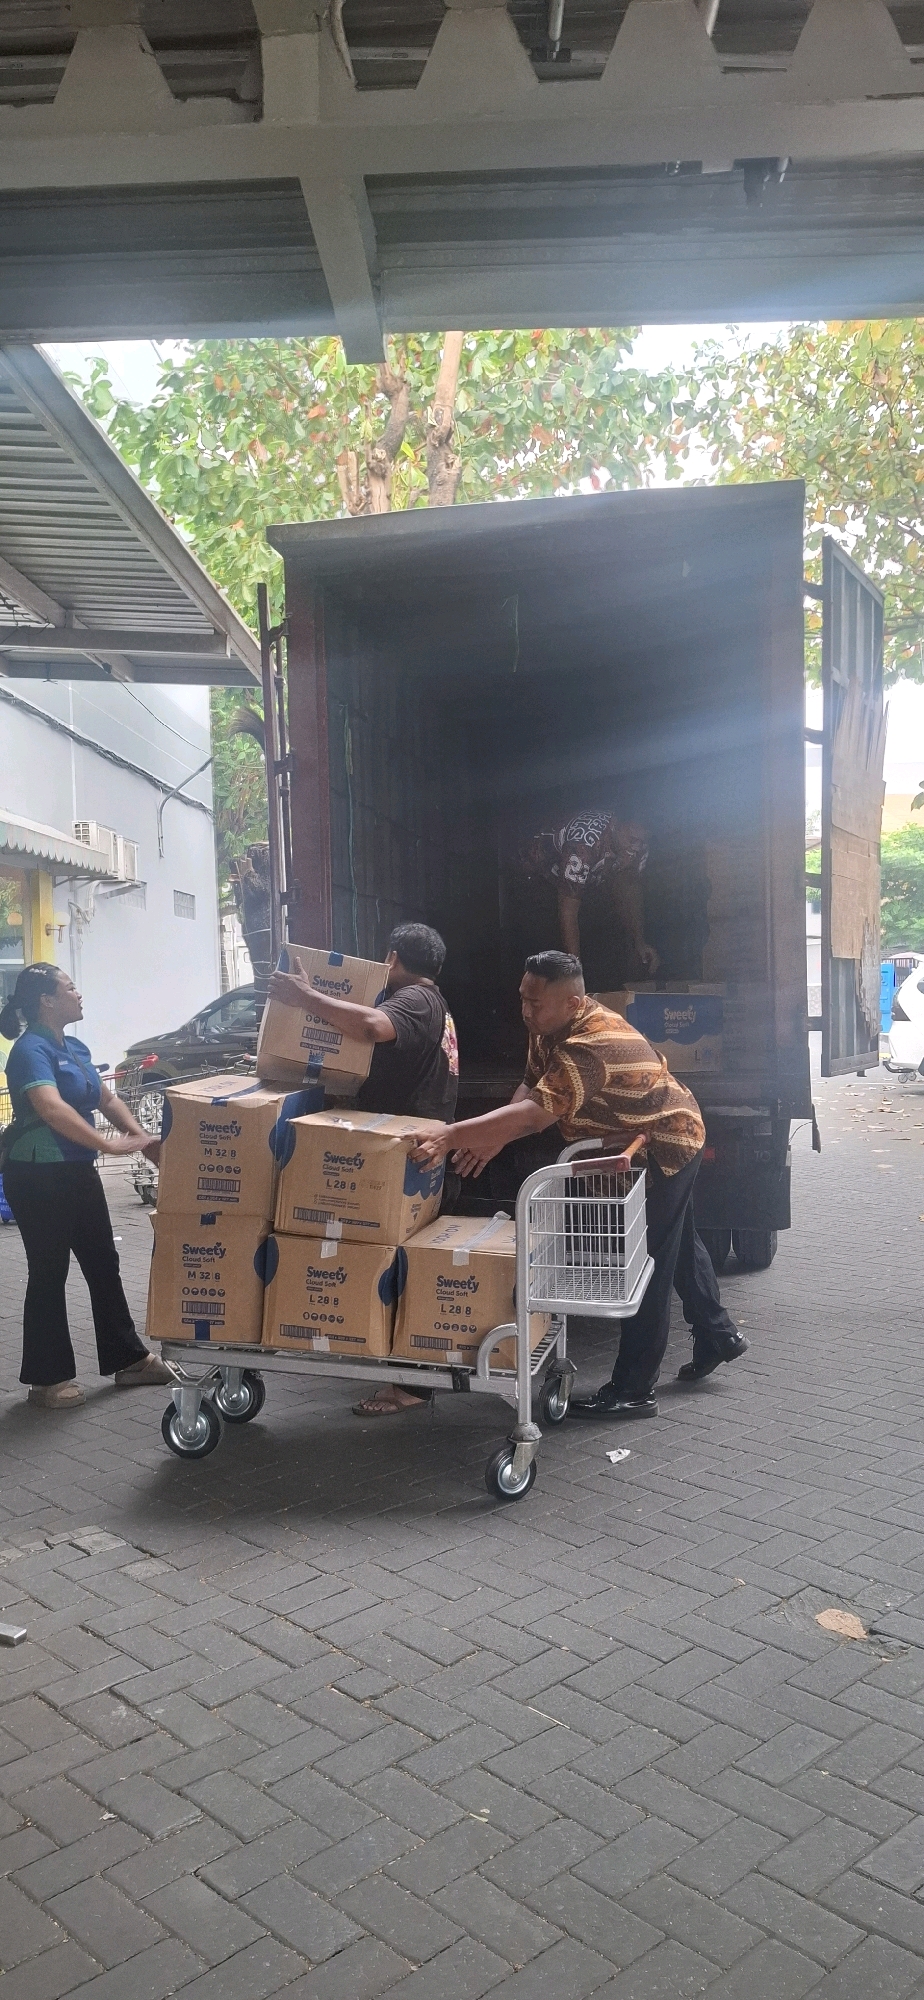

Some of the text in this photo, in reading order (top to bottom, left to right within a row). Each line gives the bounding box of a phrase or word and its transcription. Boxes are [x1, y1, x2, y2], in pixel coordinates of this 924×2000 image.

[312, 975, 352, 994] Sweety
[663, 1005, 696, 1023] Sweety
[199, 1120, 241, 1137] Sweety
[204, 1148, 237, 1158] M 32 8
[323, 1151, 365, 1170] Sweety
[326, 1179, 332, 1188] L
[333, 1180, 346, 1189] 28
[350, 1182, 357, 1191] 8
[182, 1242, 226, 1259] Sweety
[182, 1255, 201, 1263] Cloud
[187, 1271, 221, 1280] M 32 8
[306, 1265, 348, 1284] Sweety
[305, 1278, 324, 1287] Cloud
[436, 1275, 480, 1293] Sweety
[435, 1288, 469, 1298] Cloud Soft
[309, 1294, 339, 1306] L 28 8
[441, 1303, 472, 1316] L 28 8
